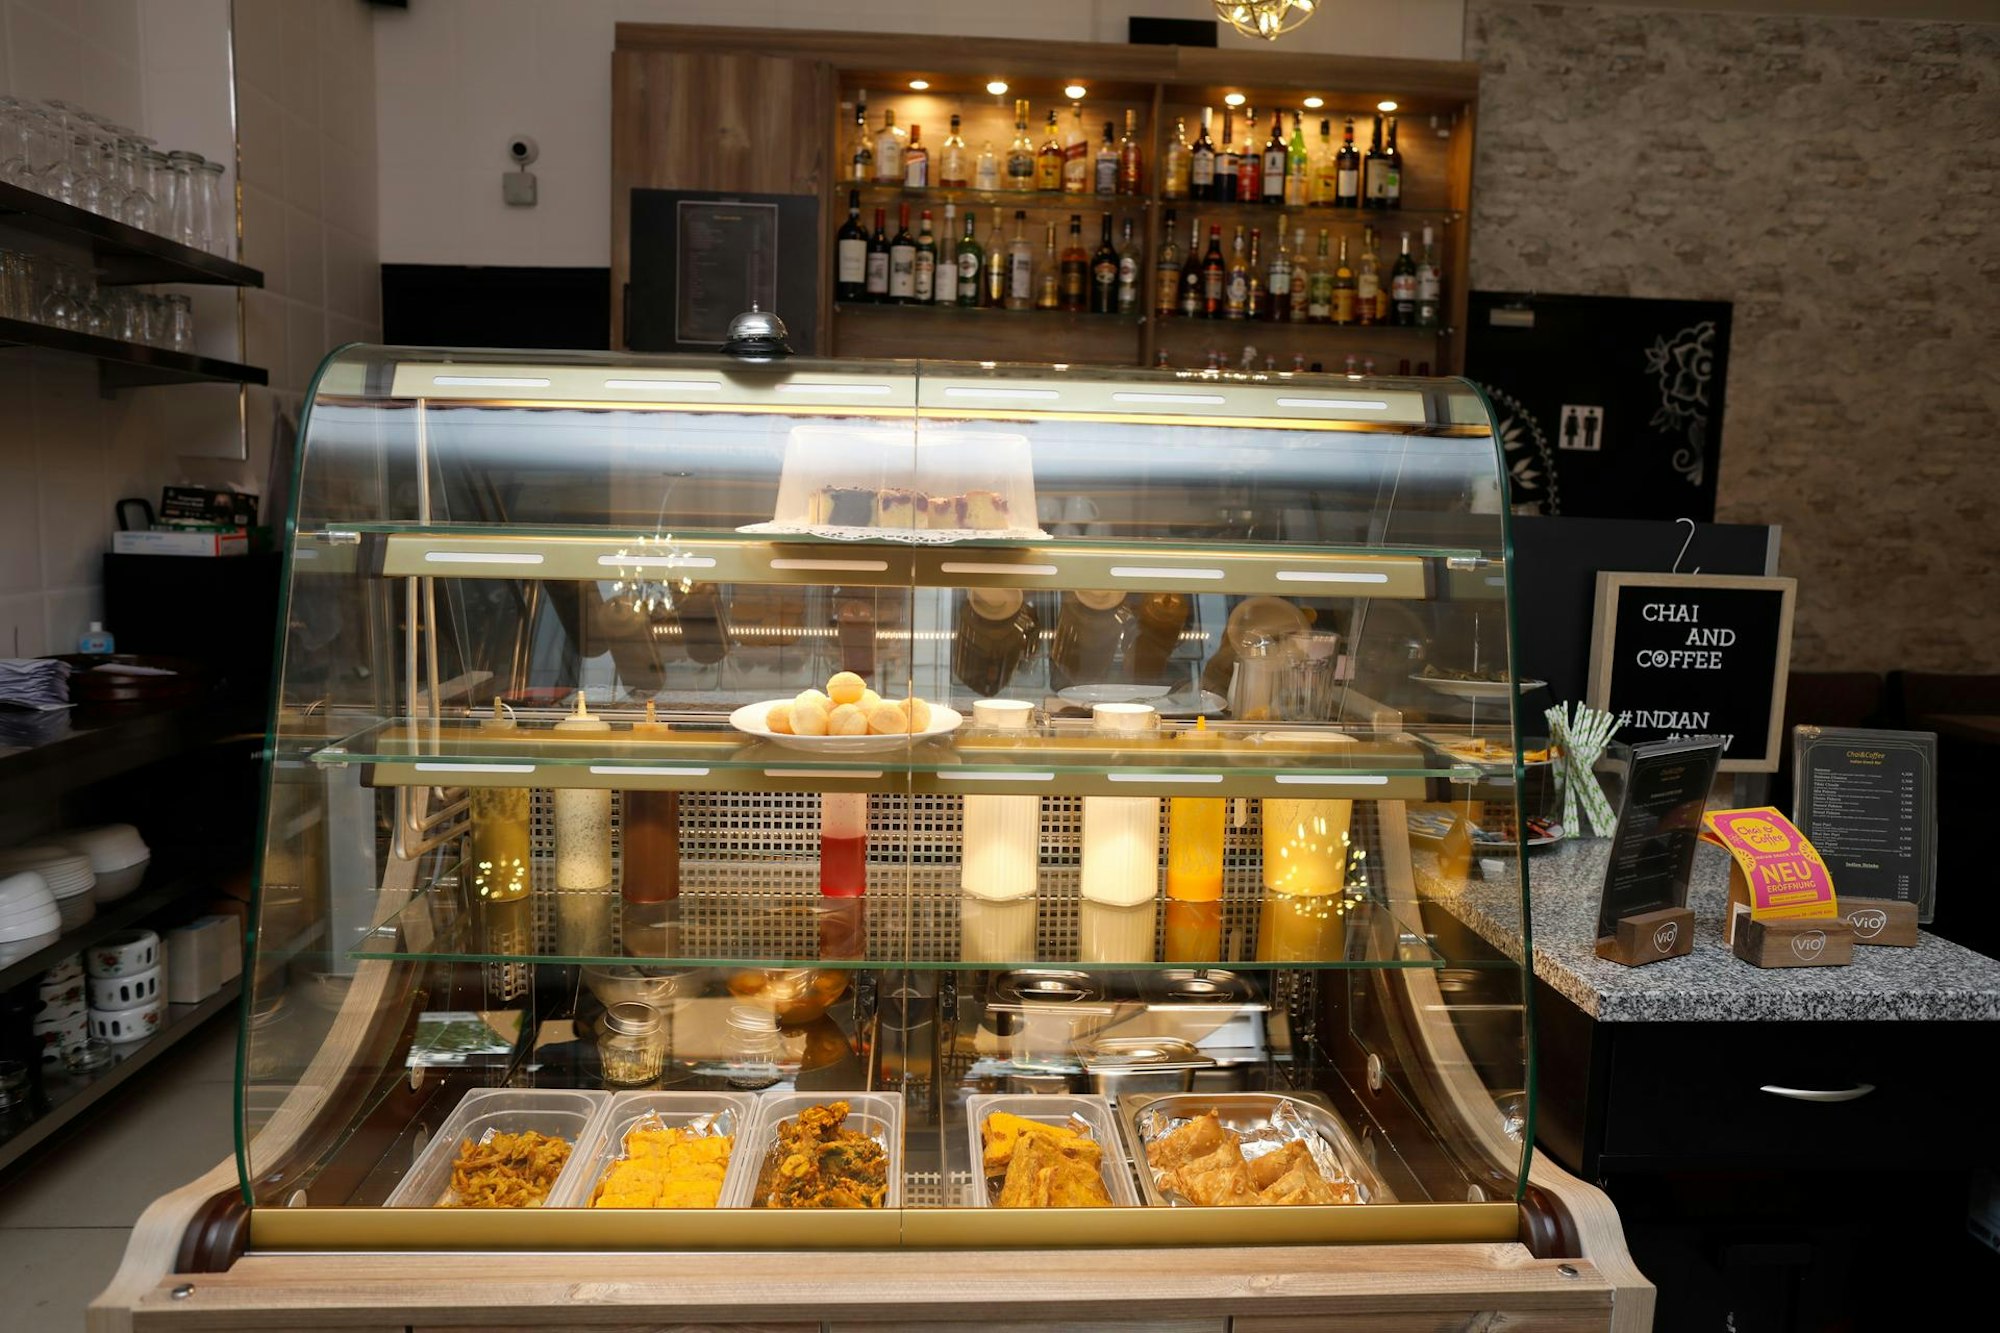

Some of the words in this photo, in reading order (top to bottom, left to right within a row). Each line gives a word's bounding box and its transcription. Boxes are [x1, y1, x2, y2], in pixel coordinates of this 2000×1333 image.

[1642, 603, 1699, 623] CHAI
[1685, 627, 1736, 647] AND
[1636, 649, 1722, 669] COFFEE
[1619, 709, 1710, 729] #INDIAN
[1737, 826, 1758, 835] Chai
[1751, 833, 1784, 846] Coffee
[1759, 861, 1812, 884] NEU
